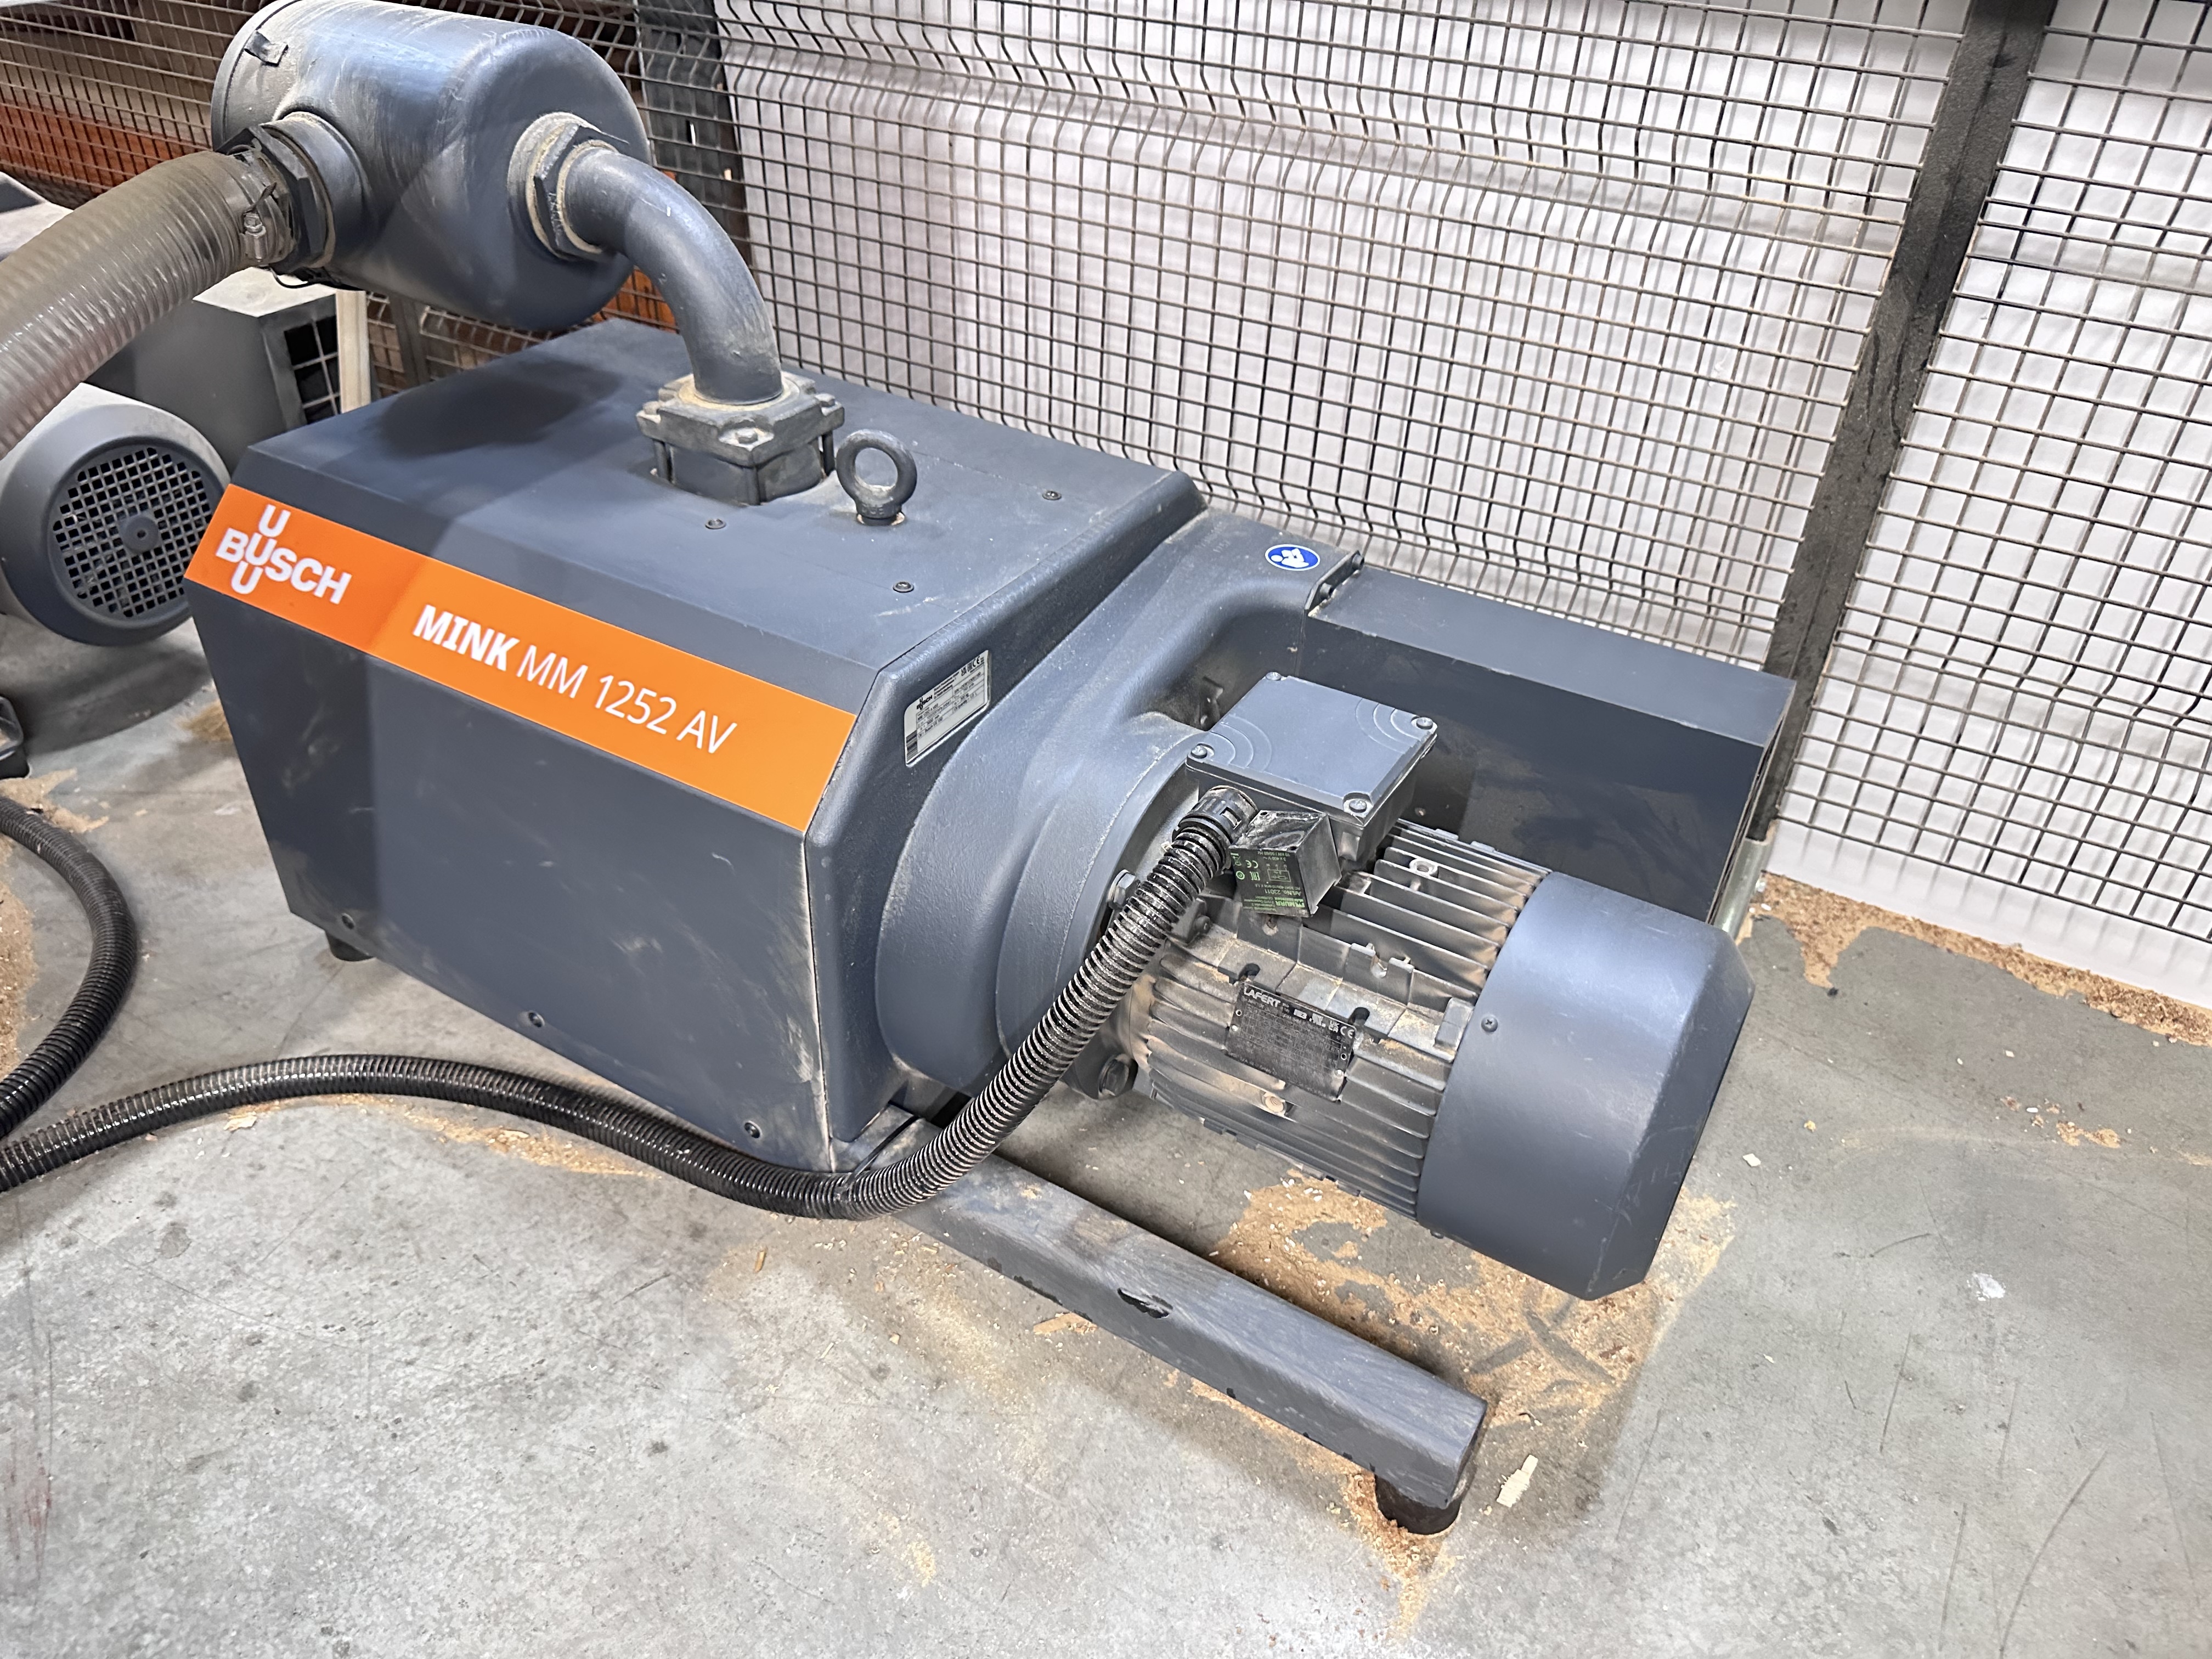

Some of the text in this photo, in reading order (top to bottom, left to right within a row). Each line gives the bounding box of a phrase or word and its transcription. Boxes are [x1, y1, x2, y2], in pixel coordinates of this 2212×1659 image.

[216, 528, 352, 604] BUSCH
[413, 604, 737, 753] MINK MM 1252 AV
[1245, 860, 1259, 868] CE
[1243, 986, 1281, 1008] LAFERT
[1340, 1025, 1355, 1039] CE
